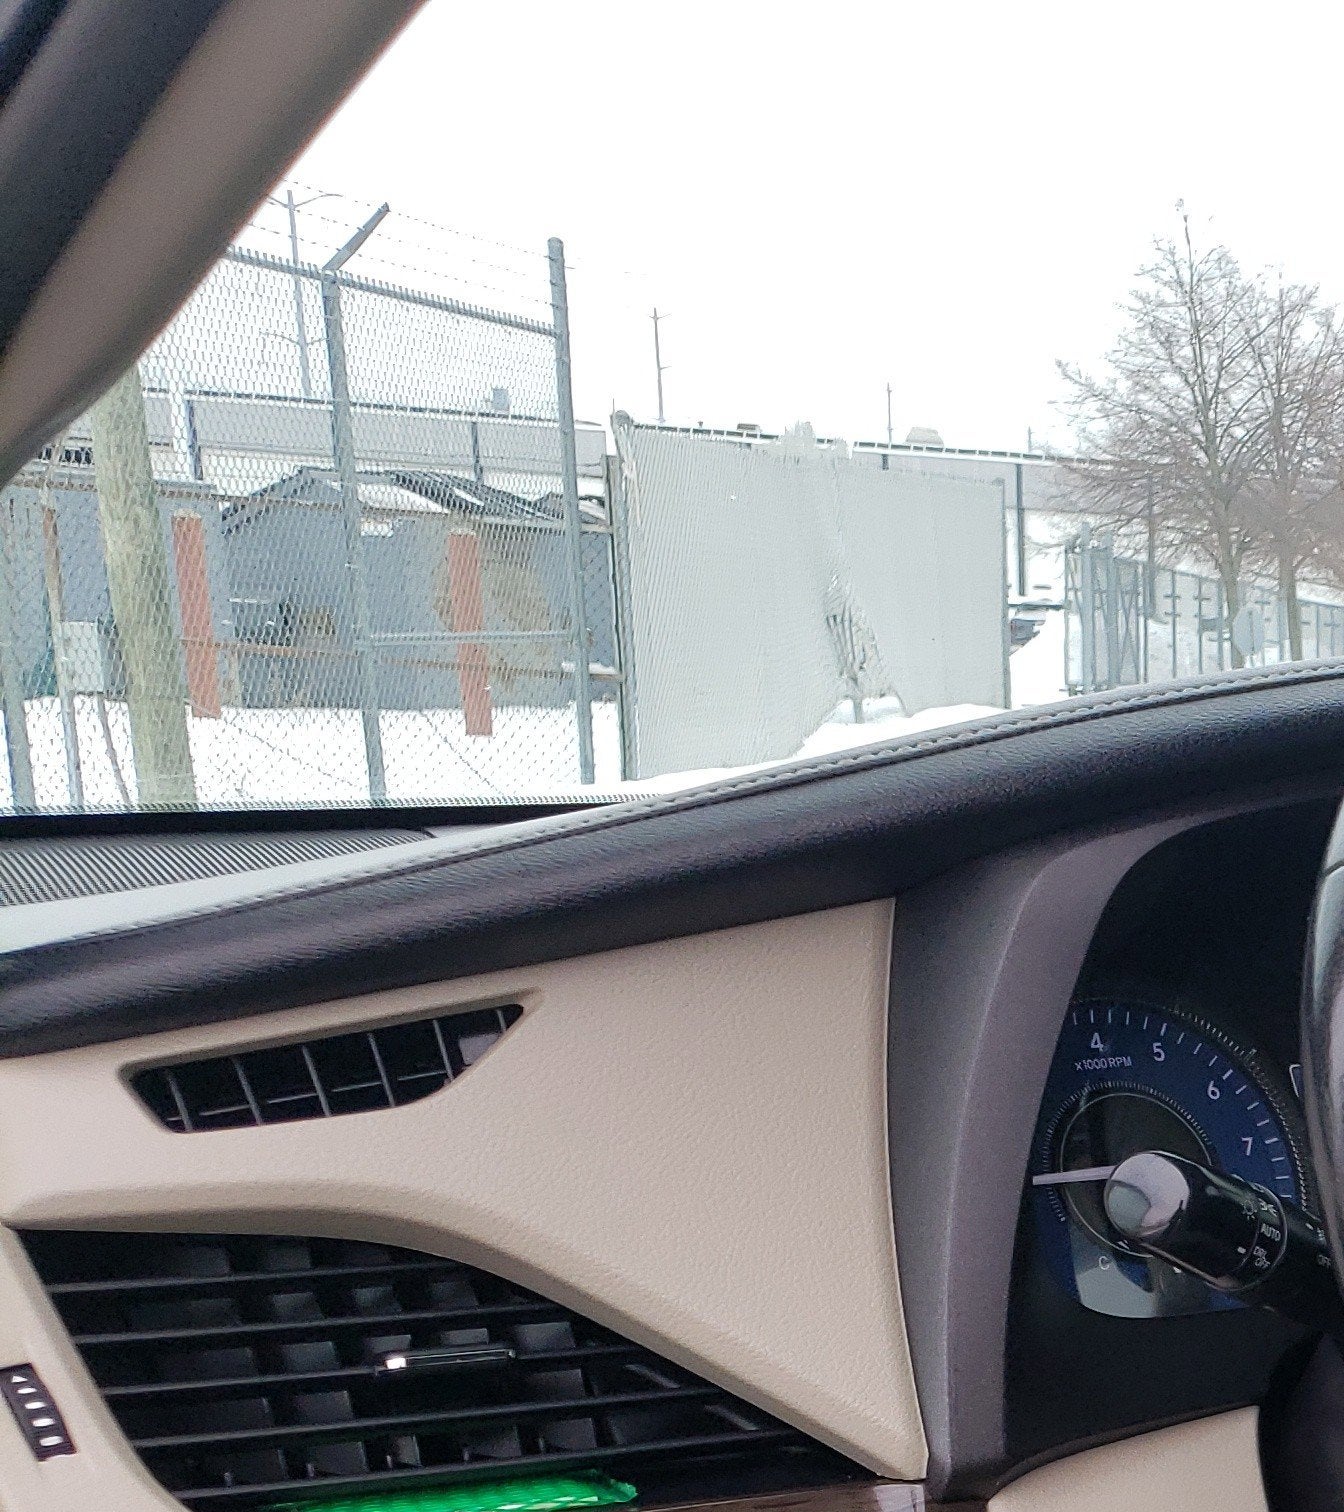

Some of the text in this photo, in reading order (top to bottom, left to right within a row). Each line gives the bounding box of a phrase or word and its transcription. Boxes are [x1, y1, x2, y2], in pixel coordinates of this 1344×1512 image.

[1090, 1032, 1105, 1052] 4
[1152, 1042, 1166, 1063] 5
[1206, 1079, 1221, 1101] 6
[1241, 1136, 1254, 1156] 7
[1261, 1223, 1281, 1242] AUTO
